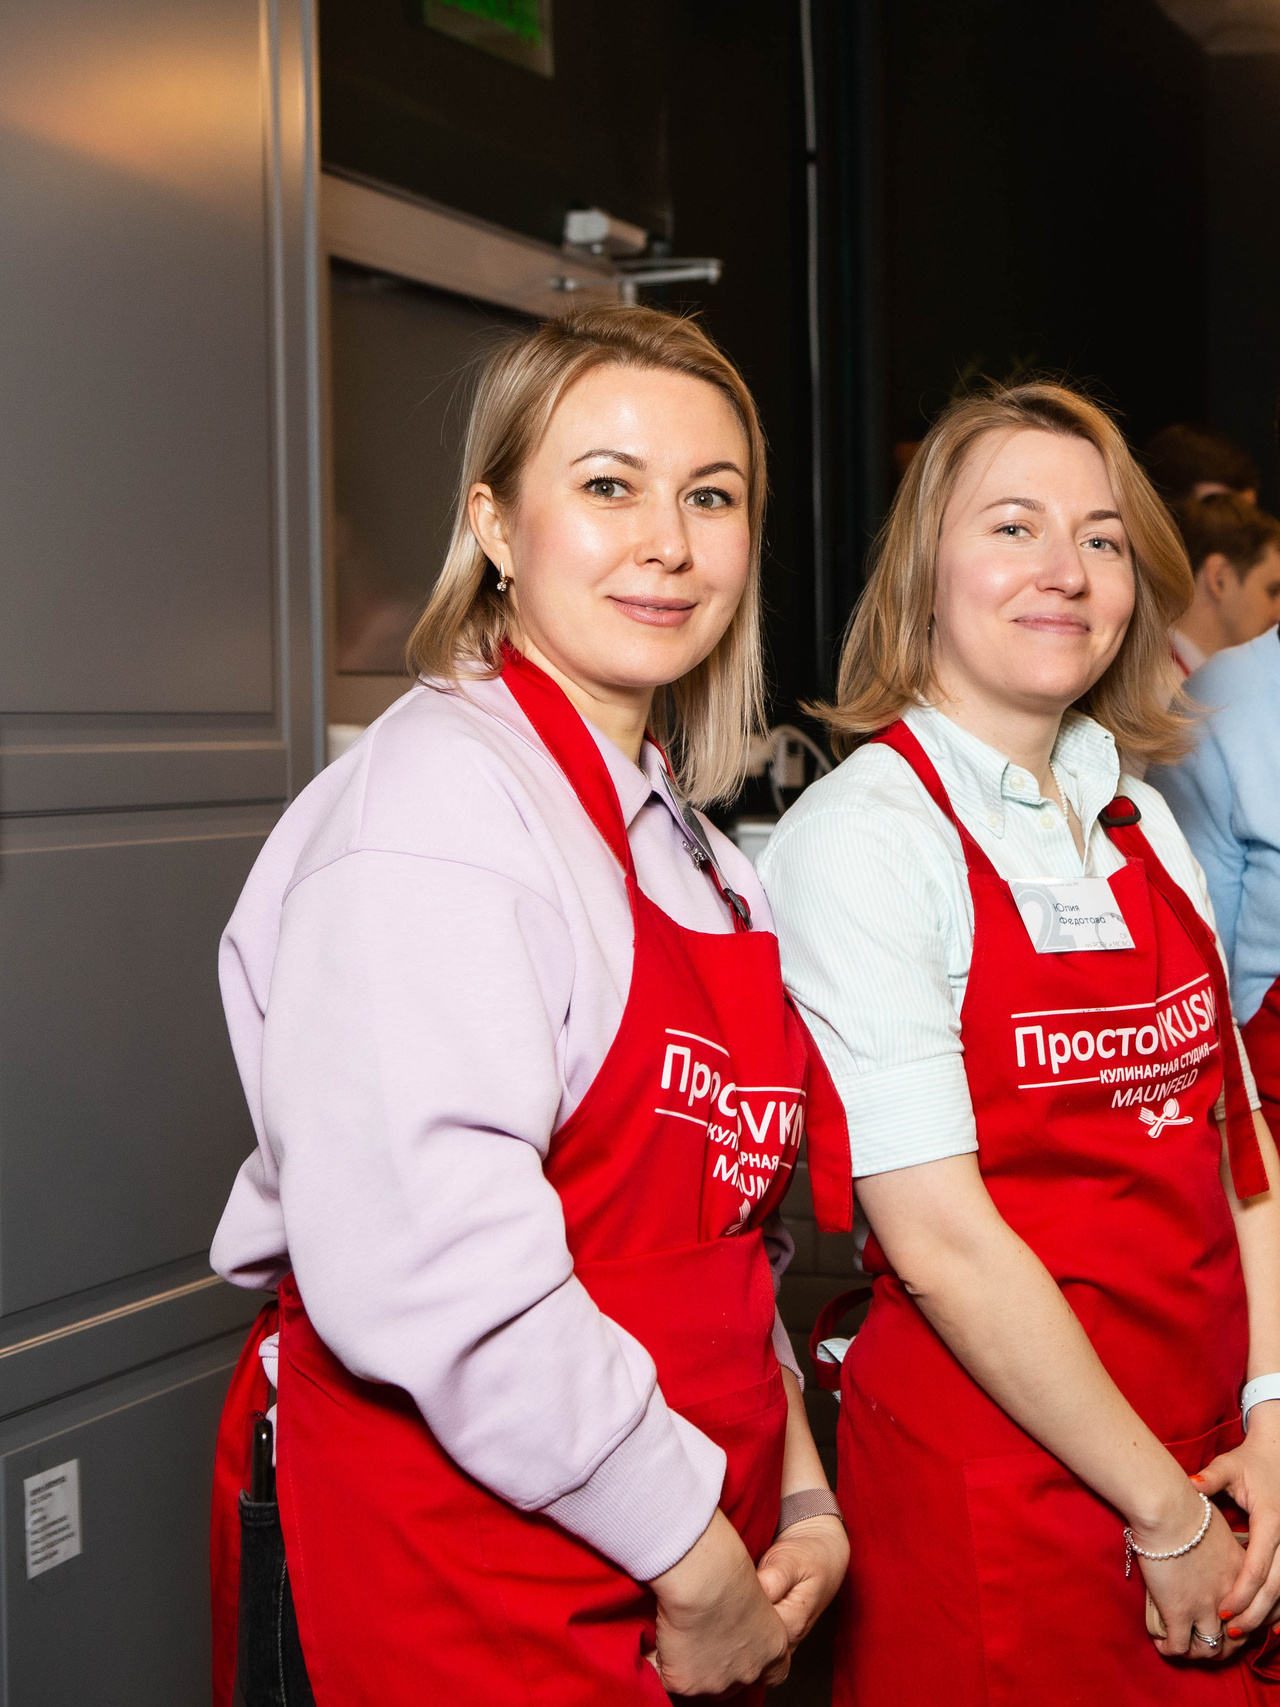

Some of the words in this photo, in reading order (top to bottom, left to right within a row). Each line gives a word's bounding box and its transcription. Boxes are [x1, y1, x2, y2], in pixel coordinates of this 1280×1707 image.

[1015, 986, 1216, 1074] ПростоKUSN
[1099, 1060, 1179, 1084] КУЛИНАРНАЯ
[1180, 1042, 1210, 1069] СТУДИЯ
[1111, 1068, 1199, 1108] MAUNFELD
